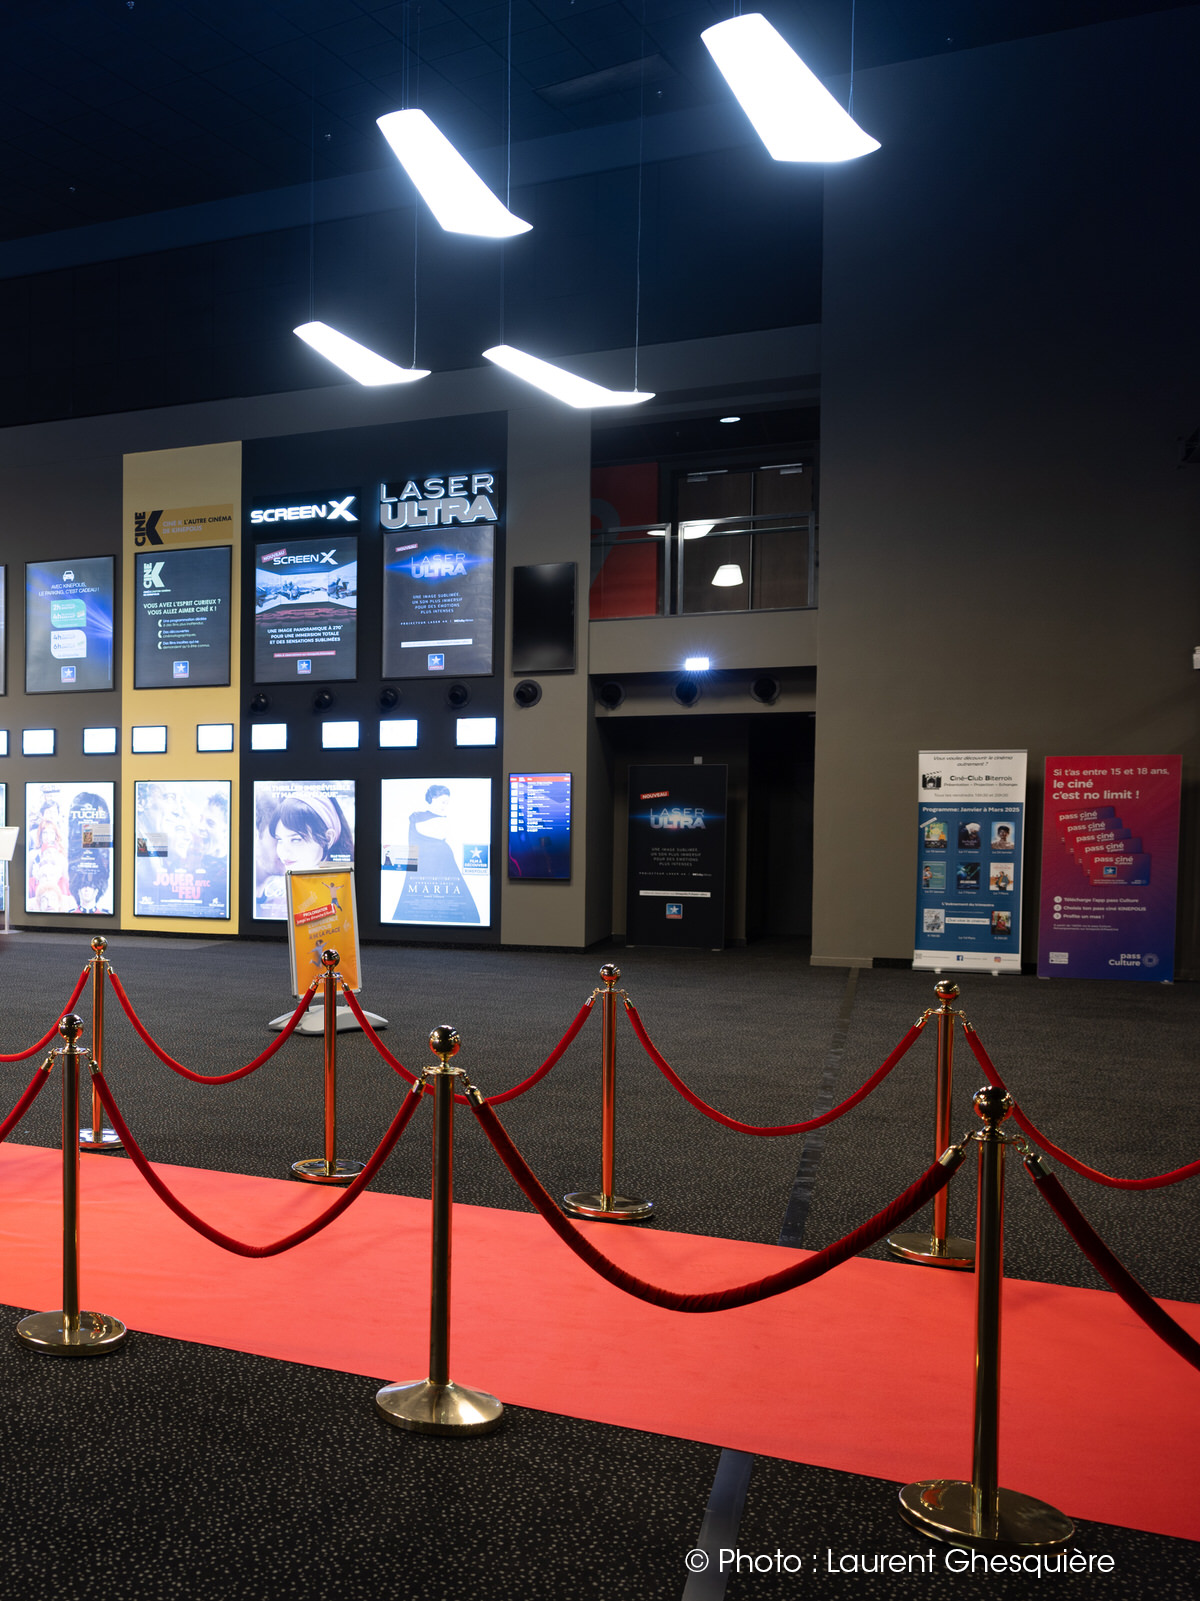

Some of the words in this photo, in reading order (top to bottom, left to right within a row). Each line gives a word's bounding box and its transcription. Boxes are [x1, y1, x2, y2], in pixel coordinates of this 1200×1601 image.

[380, 473, 494, 503] LASER
[380, 494, 498, 529] ULTRA
[183, 517, 207, 525] L'AUTRE
[207, 514, 233, 523] CINÉMA
[263, 550, 285, 561] NOUVEAU
[411, 553, 466, 564] LASER
[411, 563, 467, 578] ULTRA
[293, 625, 327, 633] PANORAMIQUE
[1053, 768, 1062, 776] Si
[1064, 768, 1081, 776] t'as
[1082, 768, 1108, 776] entre
[1110, 767, 1121, 775] 15
[1123, 768, 1134, 776] et
[1137, 767, 1148, 775] 18
[1053, 779, 1065, 788] le
[1067, 778, 1094, 788] ciné
[642, 791, 668, 799] NOUVEAU
[1052, 790, 1081, 800] c'est
[1083, 792, 1100, 800] no
[1103, 789, 1133, 800] limit
[650, 808, 705, 817] LASER
[1059, 813, 1078, 822] pass
[1079, 810, 1098, 819] ciné
[650, 815, 706, 829] ULTRA
[1067, 824, 1087, 832] pass
[1088, 821, 1105, 829] ciné
[1076, 834, 1095, 843] pass
[1096, 832, 1114, 840] ciné
[1084, 845, 1104, 853] pass
[1105, 841, 1124, 850] ciné
[1094, 856, 1114, 864] pass
[1115, 855, 1134, 863] ciné
[153, 872, 194, 887] JOUER
[179, 886, 201, 899] FEU
[408, 885, 461, 894] MARIA
[1108, 958, 1141, 967] Culture
[1120, 953, 1141, 961] pass
